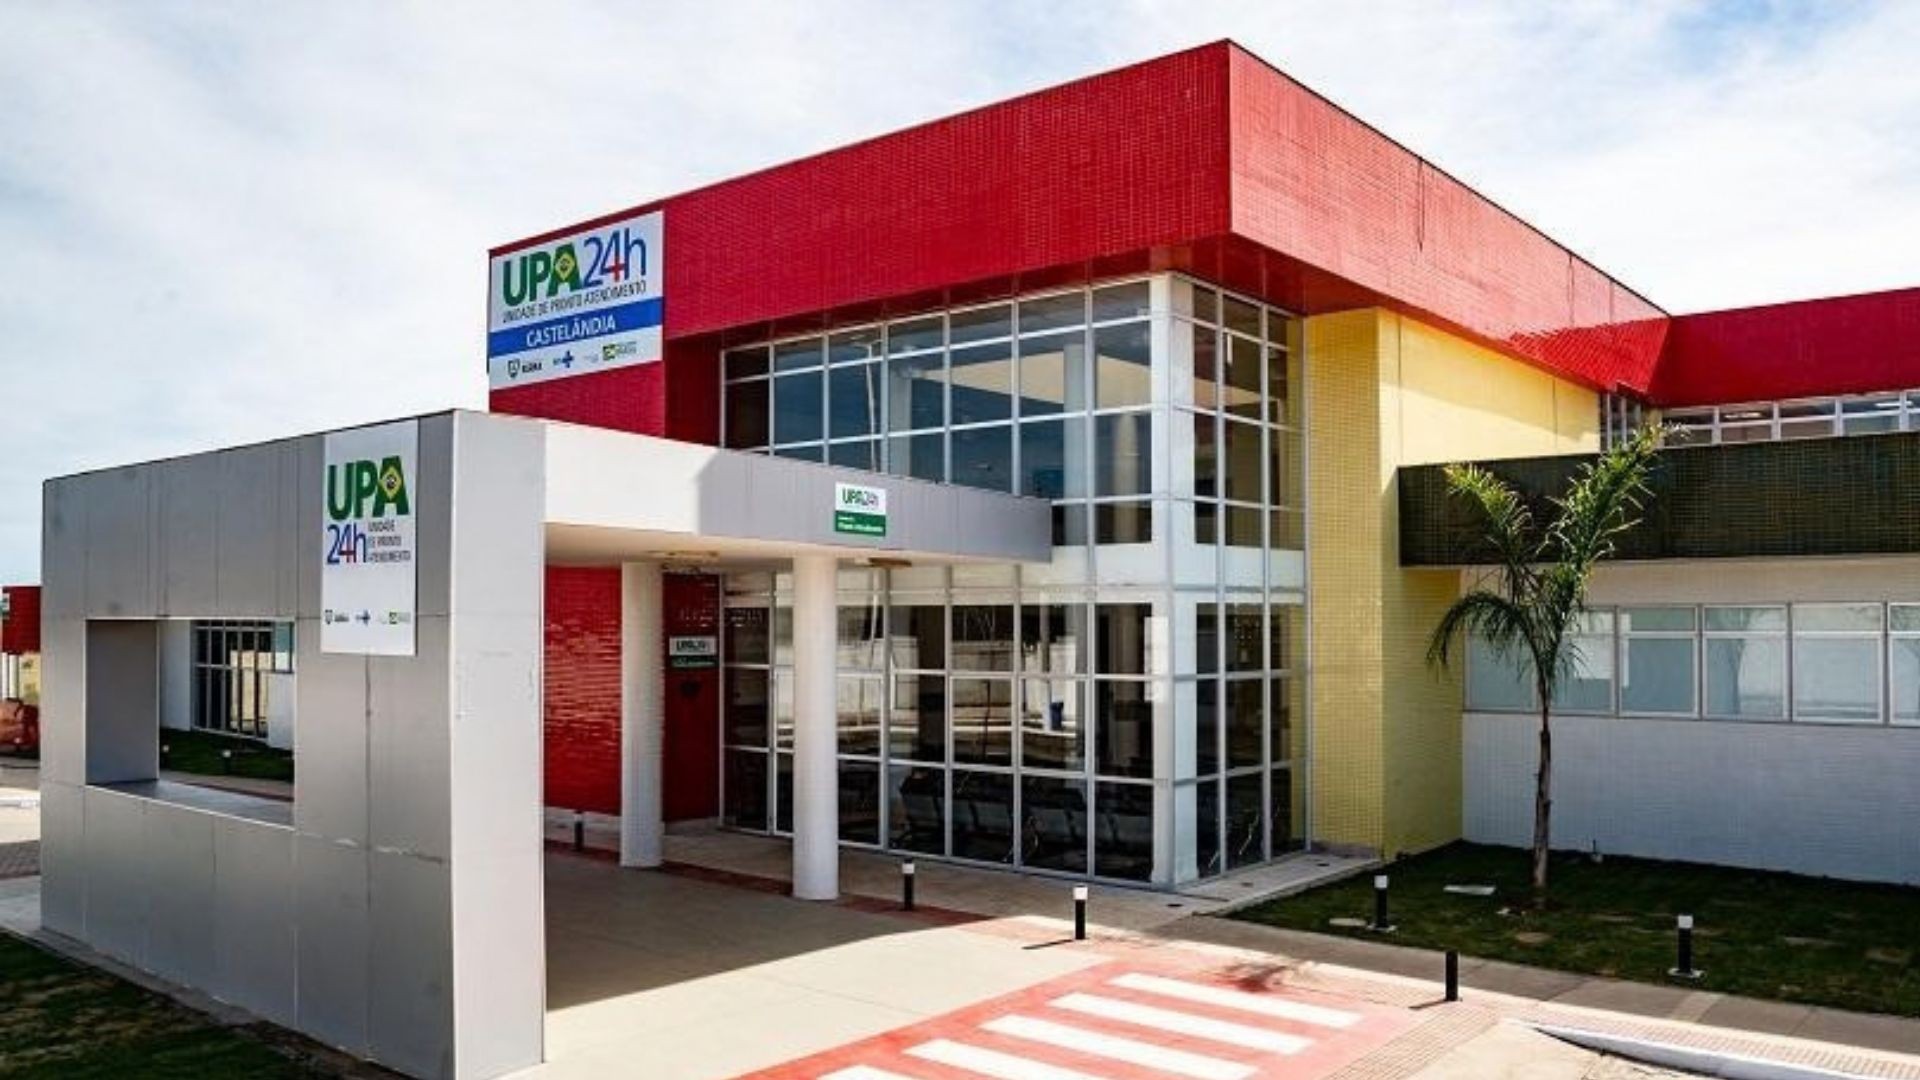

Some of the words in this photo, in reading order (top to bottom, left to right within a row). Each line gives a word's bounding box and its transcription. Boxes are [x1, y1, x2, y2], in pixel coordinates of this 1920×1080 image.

[526, 314, 616, 348] CASTELÂNDIA
[327, 455, 410, 520] UPA
[327, 522, 367, 565] 24h
